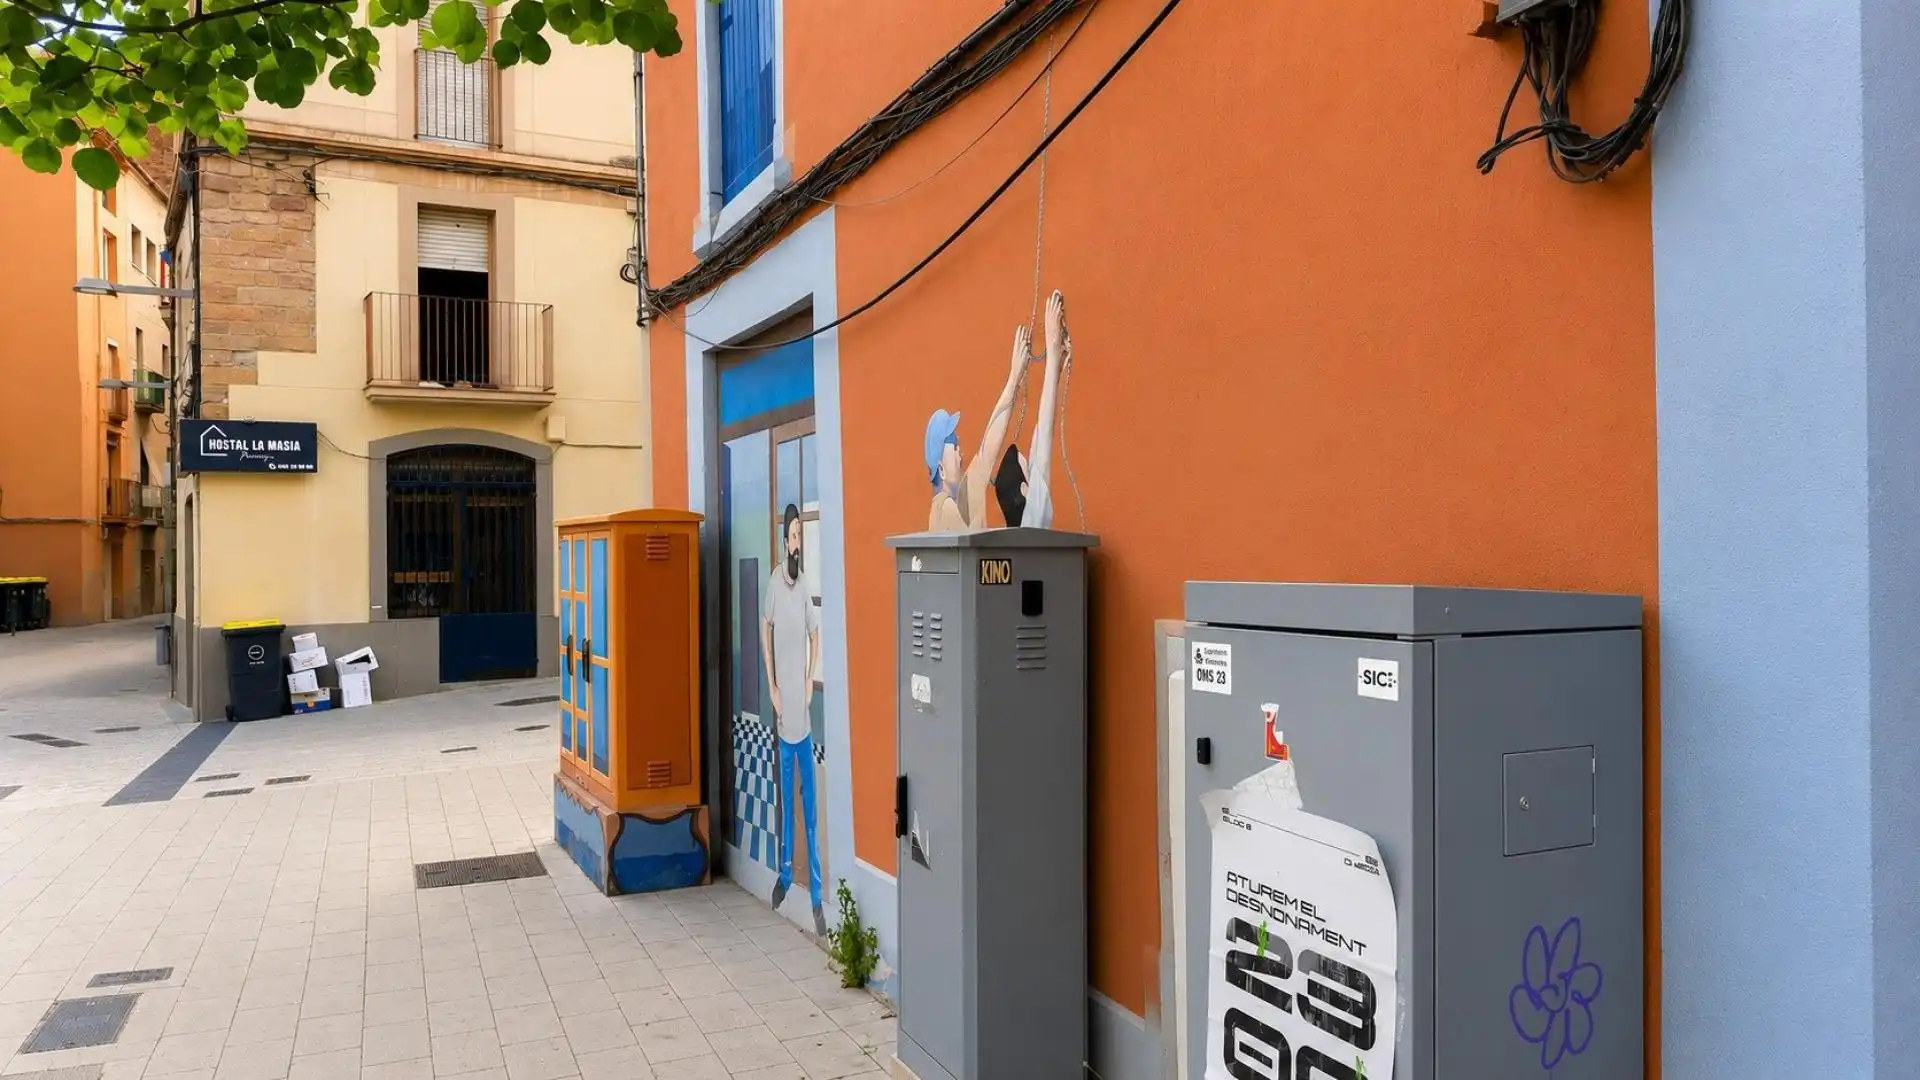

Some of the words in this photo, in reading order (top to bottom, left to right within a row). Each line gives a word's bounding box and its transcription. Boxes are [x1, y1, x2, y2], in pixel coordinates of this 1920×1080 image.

[208, 438, 249, 451] HOSTAL
[252, 440, 265, 451] LA
[267, 440, 301, 452] MASIA
[981, 560, 1010, 584] KINO
[1216, 670, 1226, 685] 23
[1226, 871, 1298, 911] ATUREM
[1300, 900, 1326, 923] EL
[1225, 887, 1368, 956] DESNONAMENT
[1225, 916, 1377, 1051] 23
